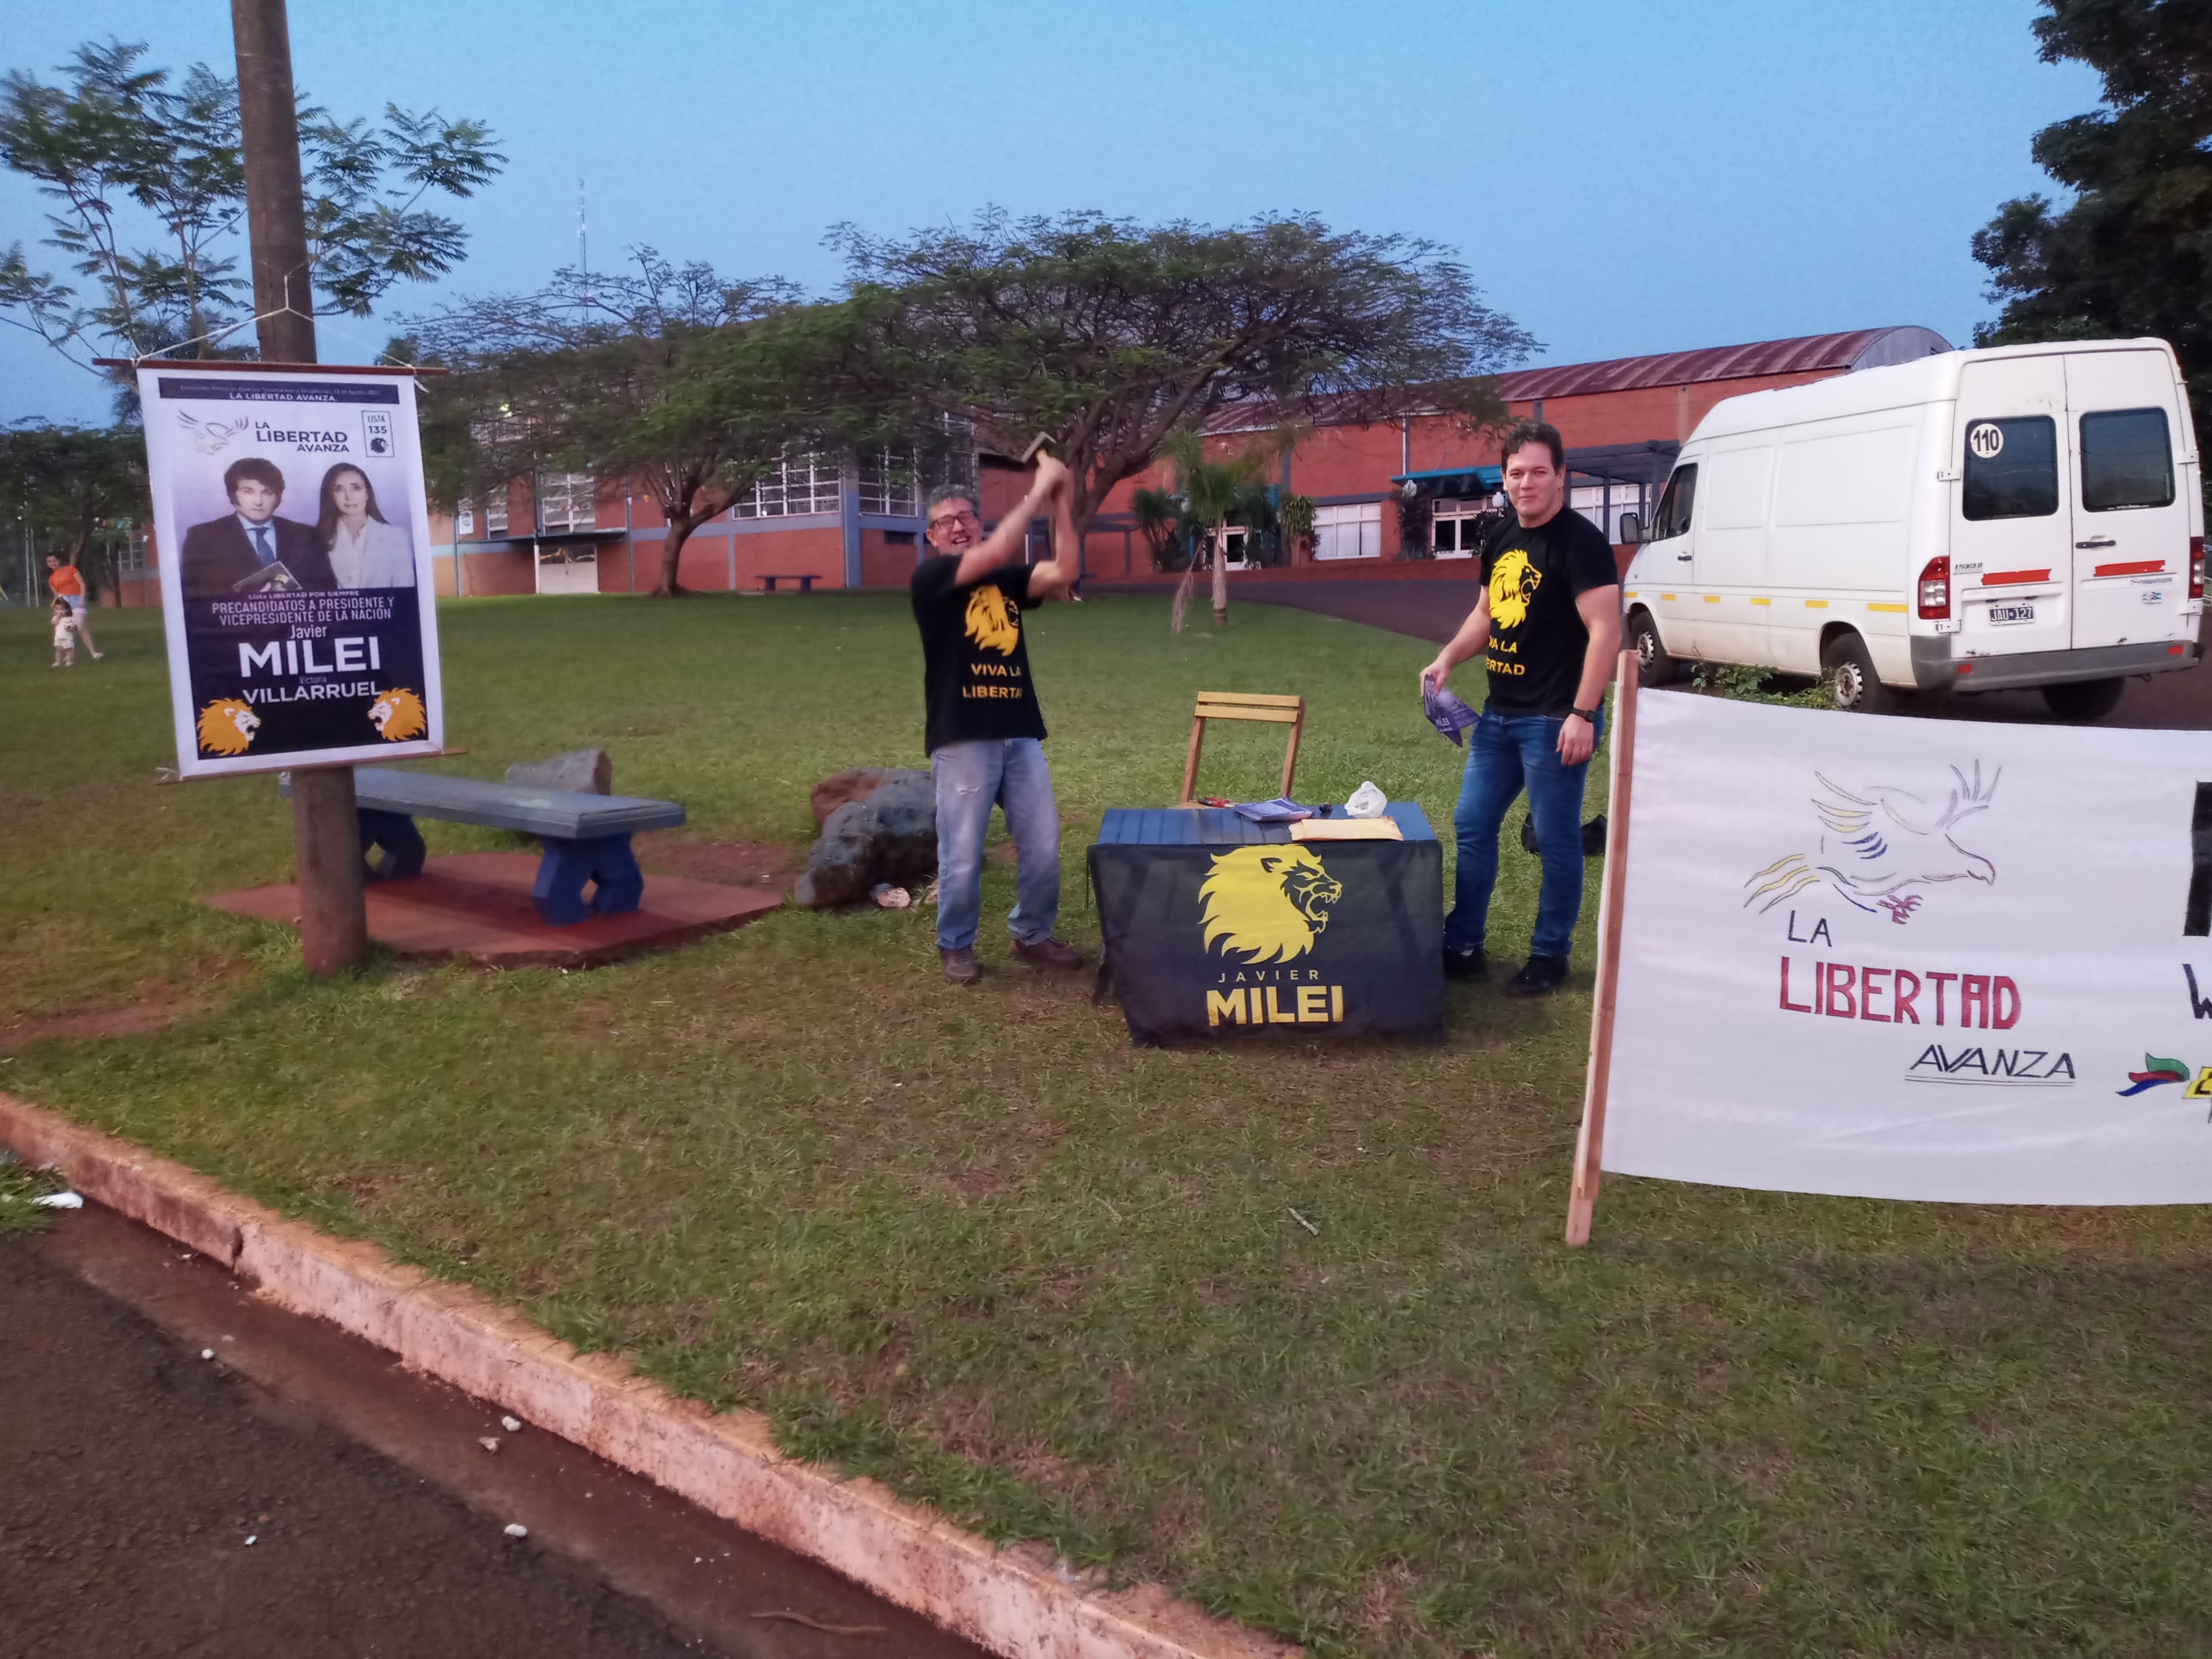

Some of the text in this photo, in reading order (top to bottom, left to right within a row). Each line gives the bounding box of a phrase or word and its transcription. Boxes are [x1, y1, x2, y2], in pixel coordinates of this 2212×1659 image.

[256, 430, 348, 443] LIBERTAD
[369, 426, 387, 434] 135
[297, 444, 350, 452] AVANZA
[1974, 429, 1999, 452] 110
[211, 596, 394, 614] PRECANDIDATOS A PRESIDENTE Y
[219, 611, 315, 626] VICEPRESIDENTE
[317, 610, 332, 622] DE
[335, 609, 349, 621] LA
[290, 624, 327, 639] Javier
[1500, 640, 1517, 654] LA
[238, 636, 380, 677] MILEI
[971, 662, 1021, 677] VIVA LA
[299, 676, 327, 684] Victoria
[243, 681, 382, 704] VILLARRUEL
[962, 684, 1023, 699] LIBERTA
[1787, 910, 1832, 948] LA
[1218, 969, 1319, 984] JAVIER
[1779, 956, 2021, 1031] LIBERTAD
[1206, 985, 1344, 1028] MILEI
[1910, 1044, 2076, 1079] AVANZA
